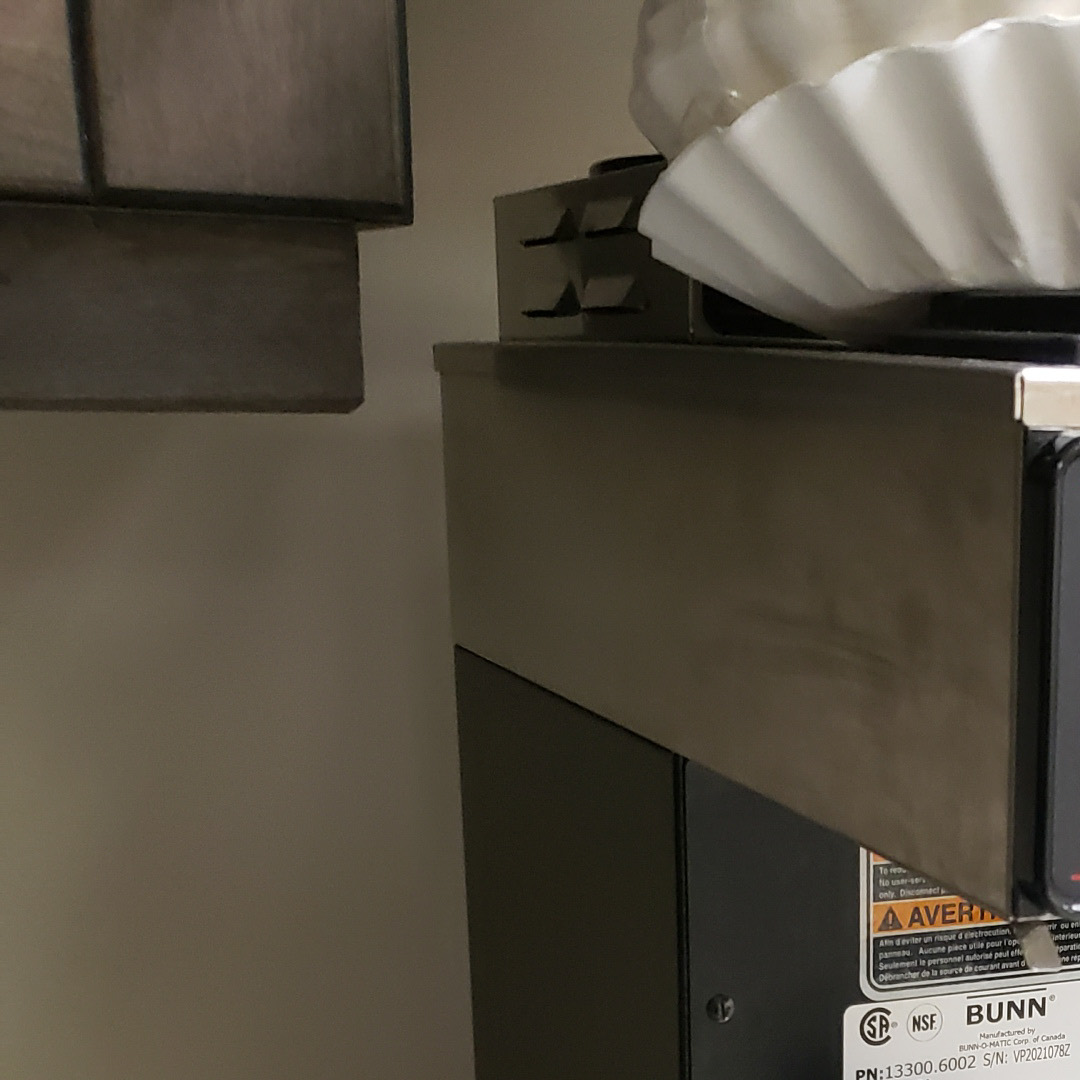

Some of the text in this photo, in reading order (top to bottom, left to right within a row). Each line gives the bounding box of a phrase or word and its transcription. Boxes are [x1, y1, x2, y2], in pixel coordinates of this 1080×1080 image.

[912, 1013, 937, 1032] NSF
[958, 1039, 1012, 1052] BUNN-O-MATIC
[1032, 1035, 1040, 1043] of
[1041, 1032, 1066, 1042] Canada
[979, 1027, 1036, 1040] Manufactured by
[983, 1050, 1008, 1068] S/N:
